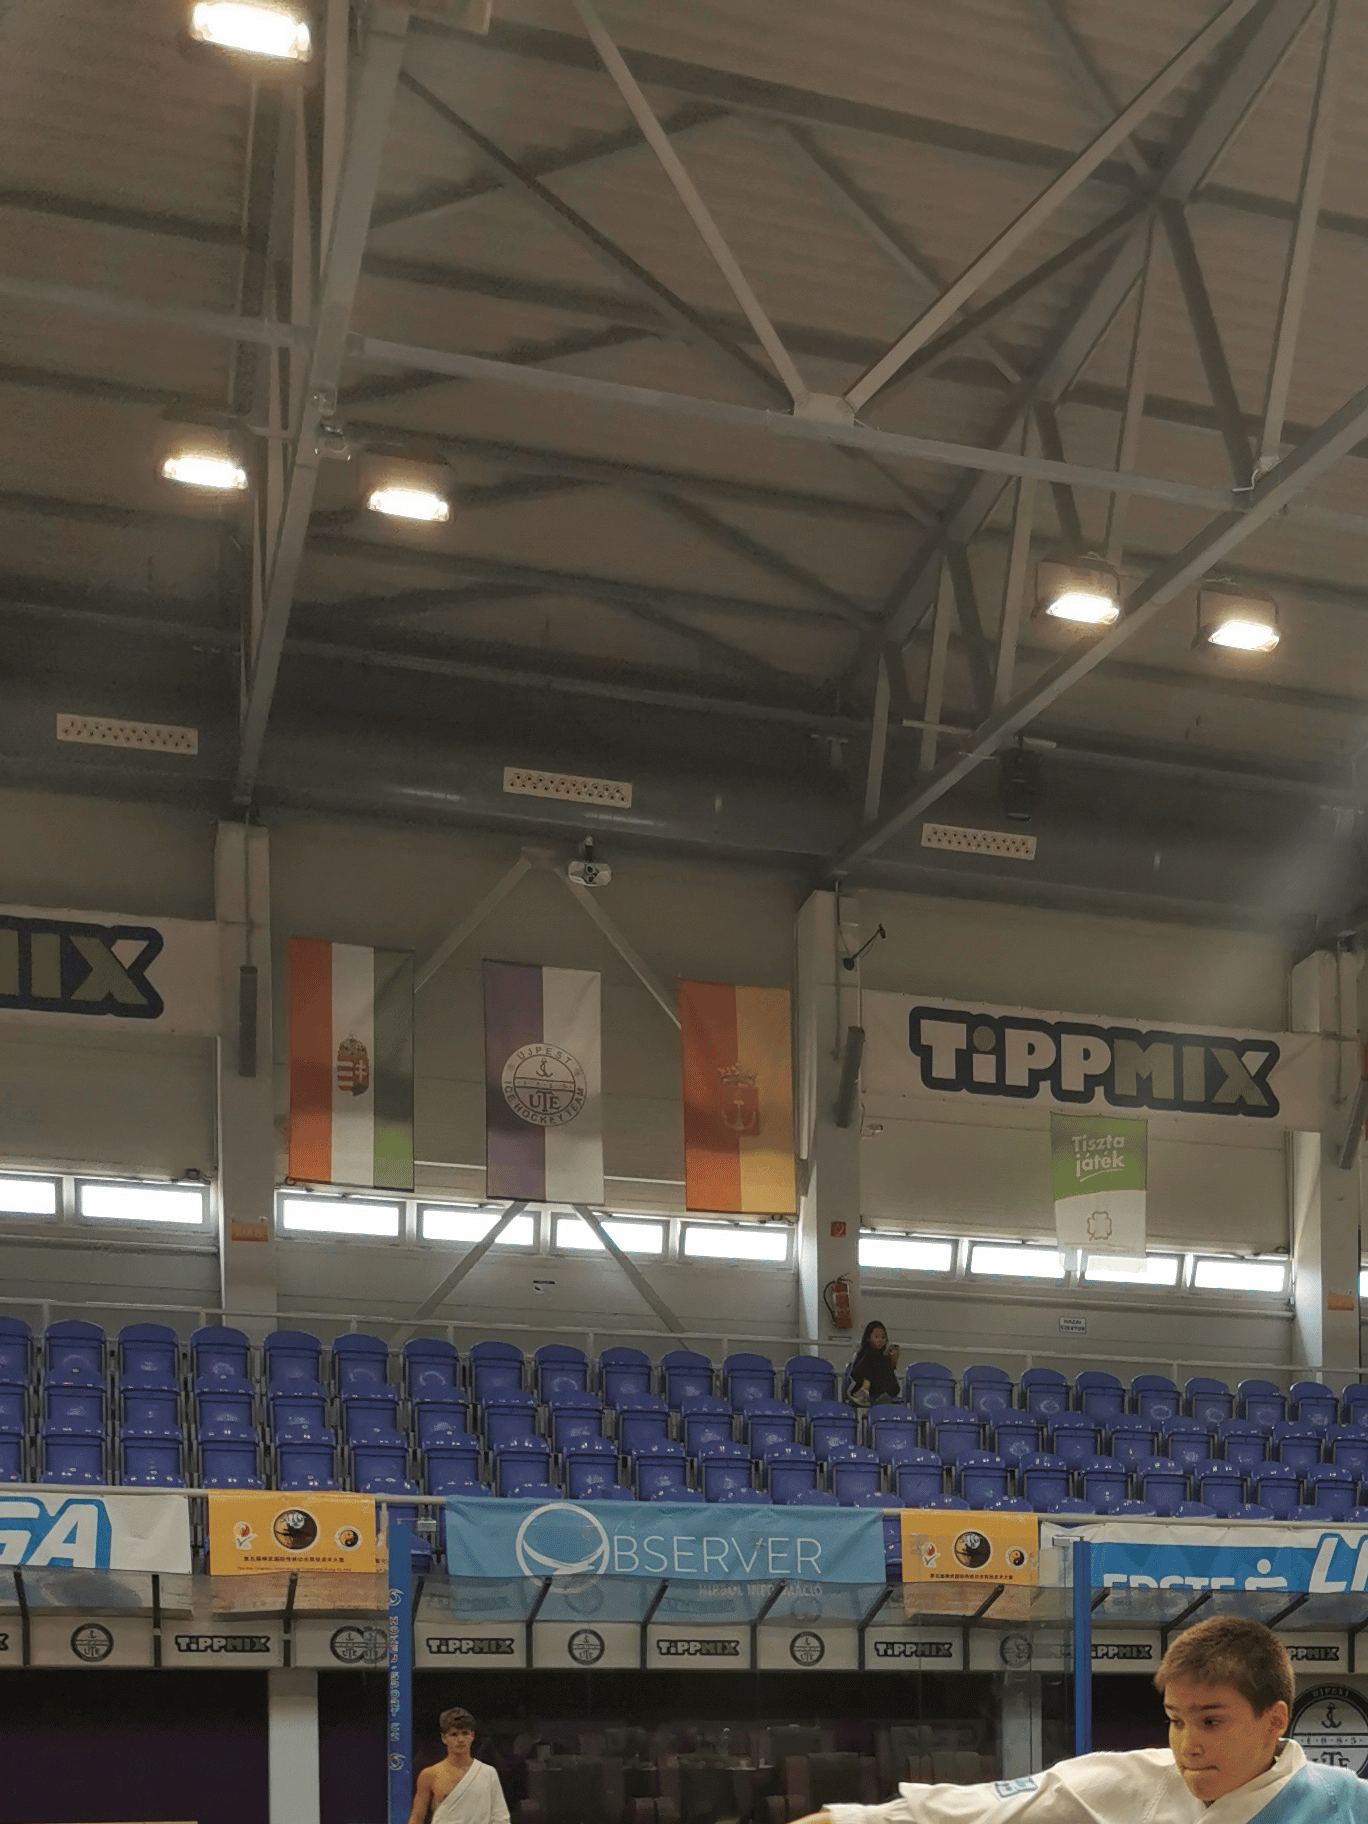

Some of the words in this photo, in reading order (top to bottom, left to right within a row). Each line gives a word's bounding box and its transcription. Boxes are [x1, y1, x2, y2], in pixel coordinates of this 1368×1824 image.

[528, 1090, 562, 1113] UTE
[1071, 1134, 1125, 1152] Tiszta
[1076, 1150, 1126, 1178] játék
